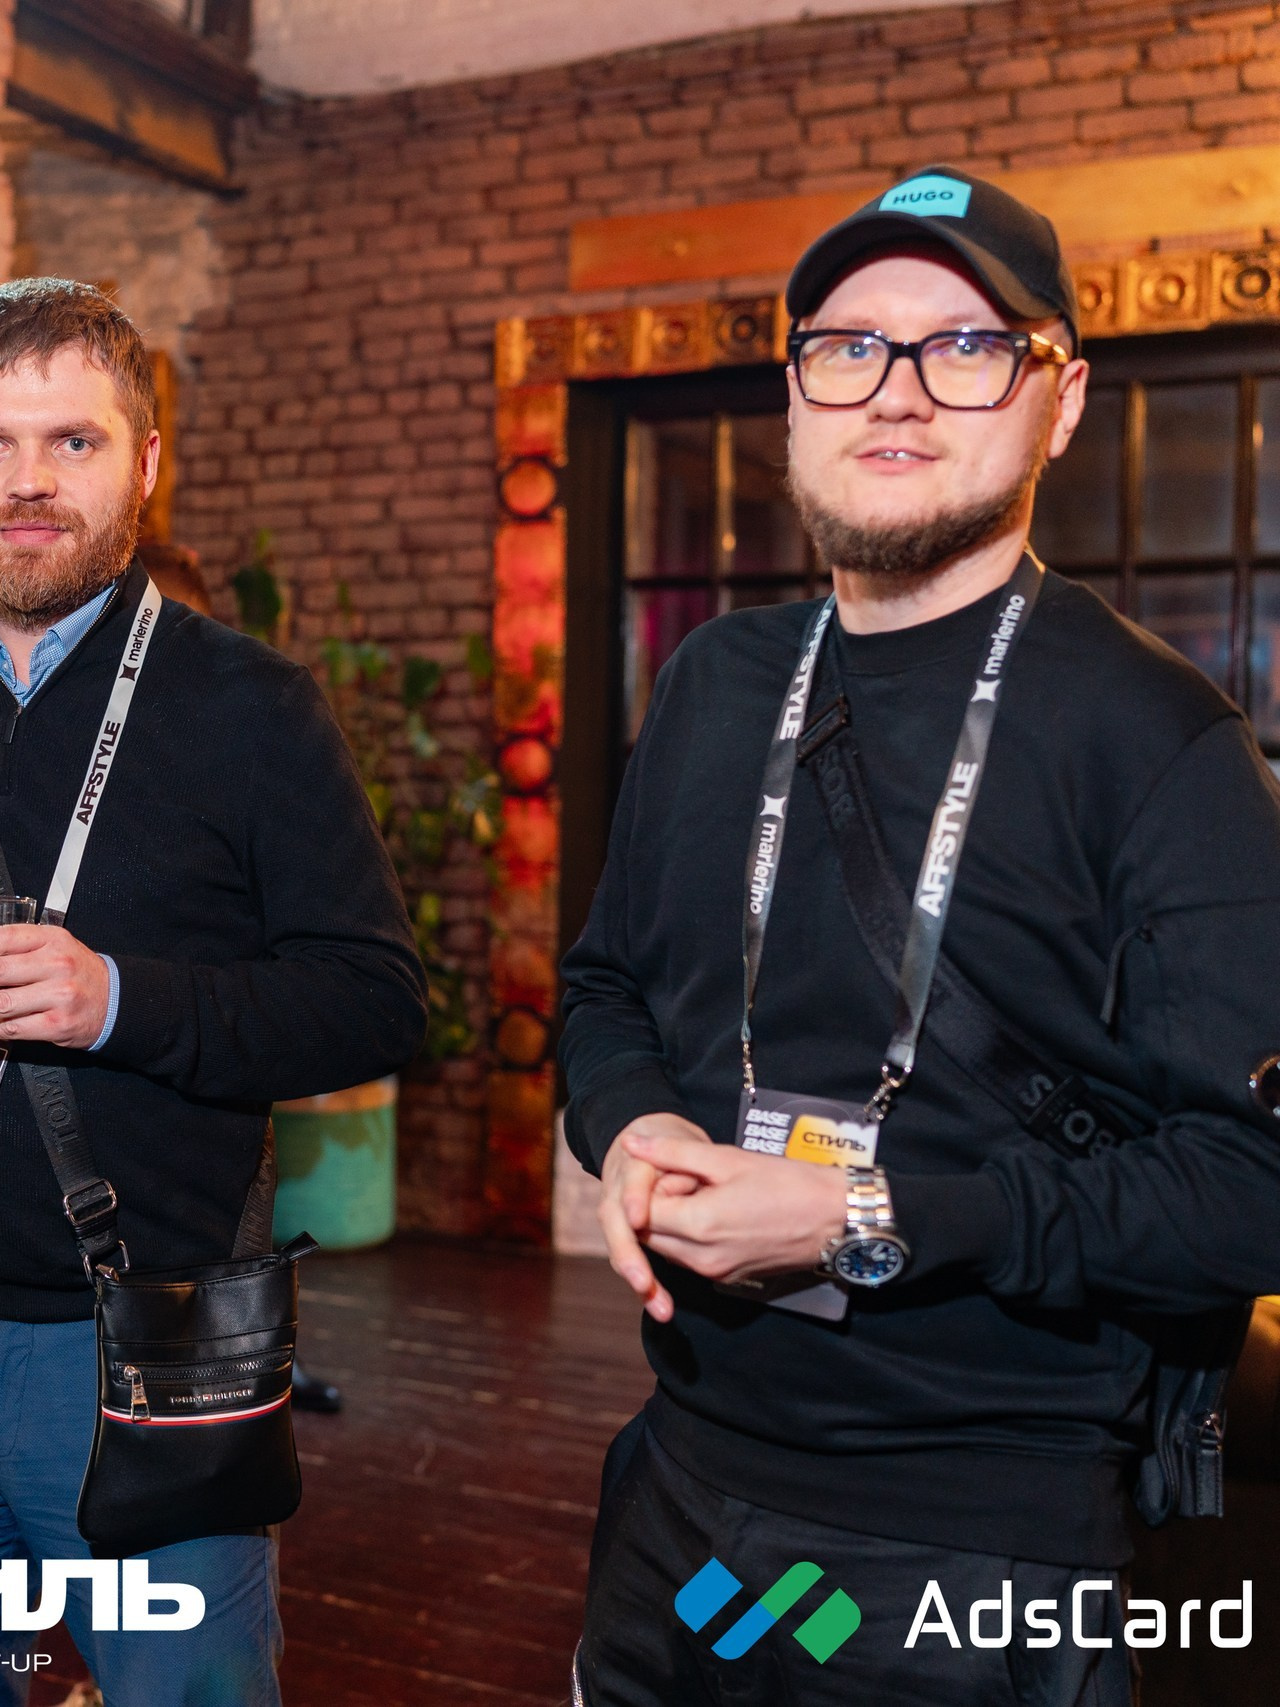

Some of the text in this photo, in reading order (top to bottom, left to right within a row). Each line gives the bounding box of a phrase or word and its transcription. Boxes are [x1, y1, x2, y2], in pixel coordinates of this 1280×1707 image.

[892, 190, 954, 205] HUGO
[129, 607, 154, 662] marlerino
[983, 595, 1026, 675] marlerino
[780, 609, 833, 741] AFFSTYLE
[75, 720, 121, 826] AFFSTYLE
[919, 762, 979, 918] AFFSTYLE
[750, 822, 779, 915] marlerino
[743, 1122, 790, 1142] BASE
[745, 1108, 792, 1128] BASE
[741, 1136, 787, 1156] BASE
[803, 1131, 867, 1152] СТИЛЬ
[214, 1389, 255, 1401] HILFIGER
